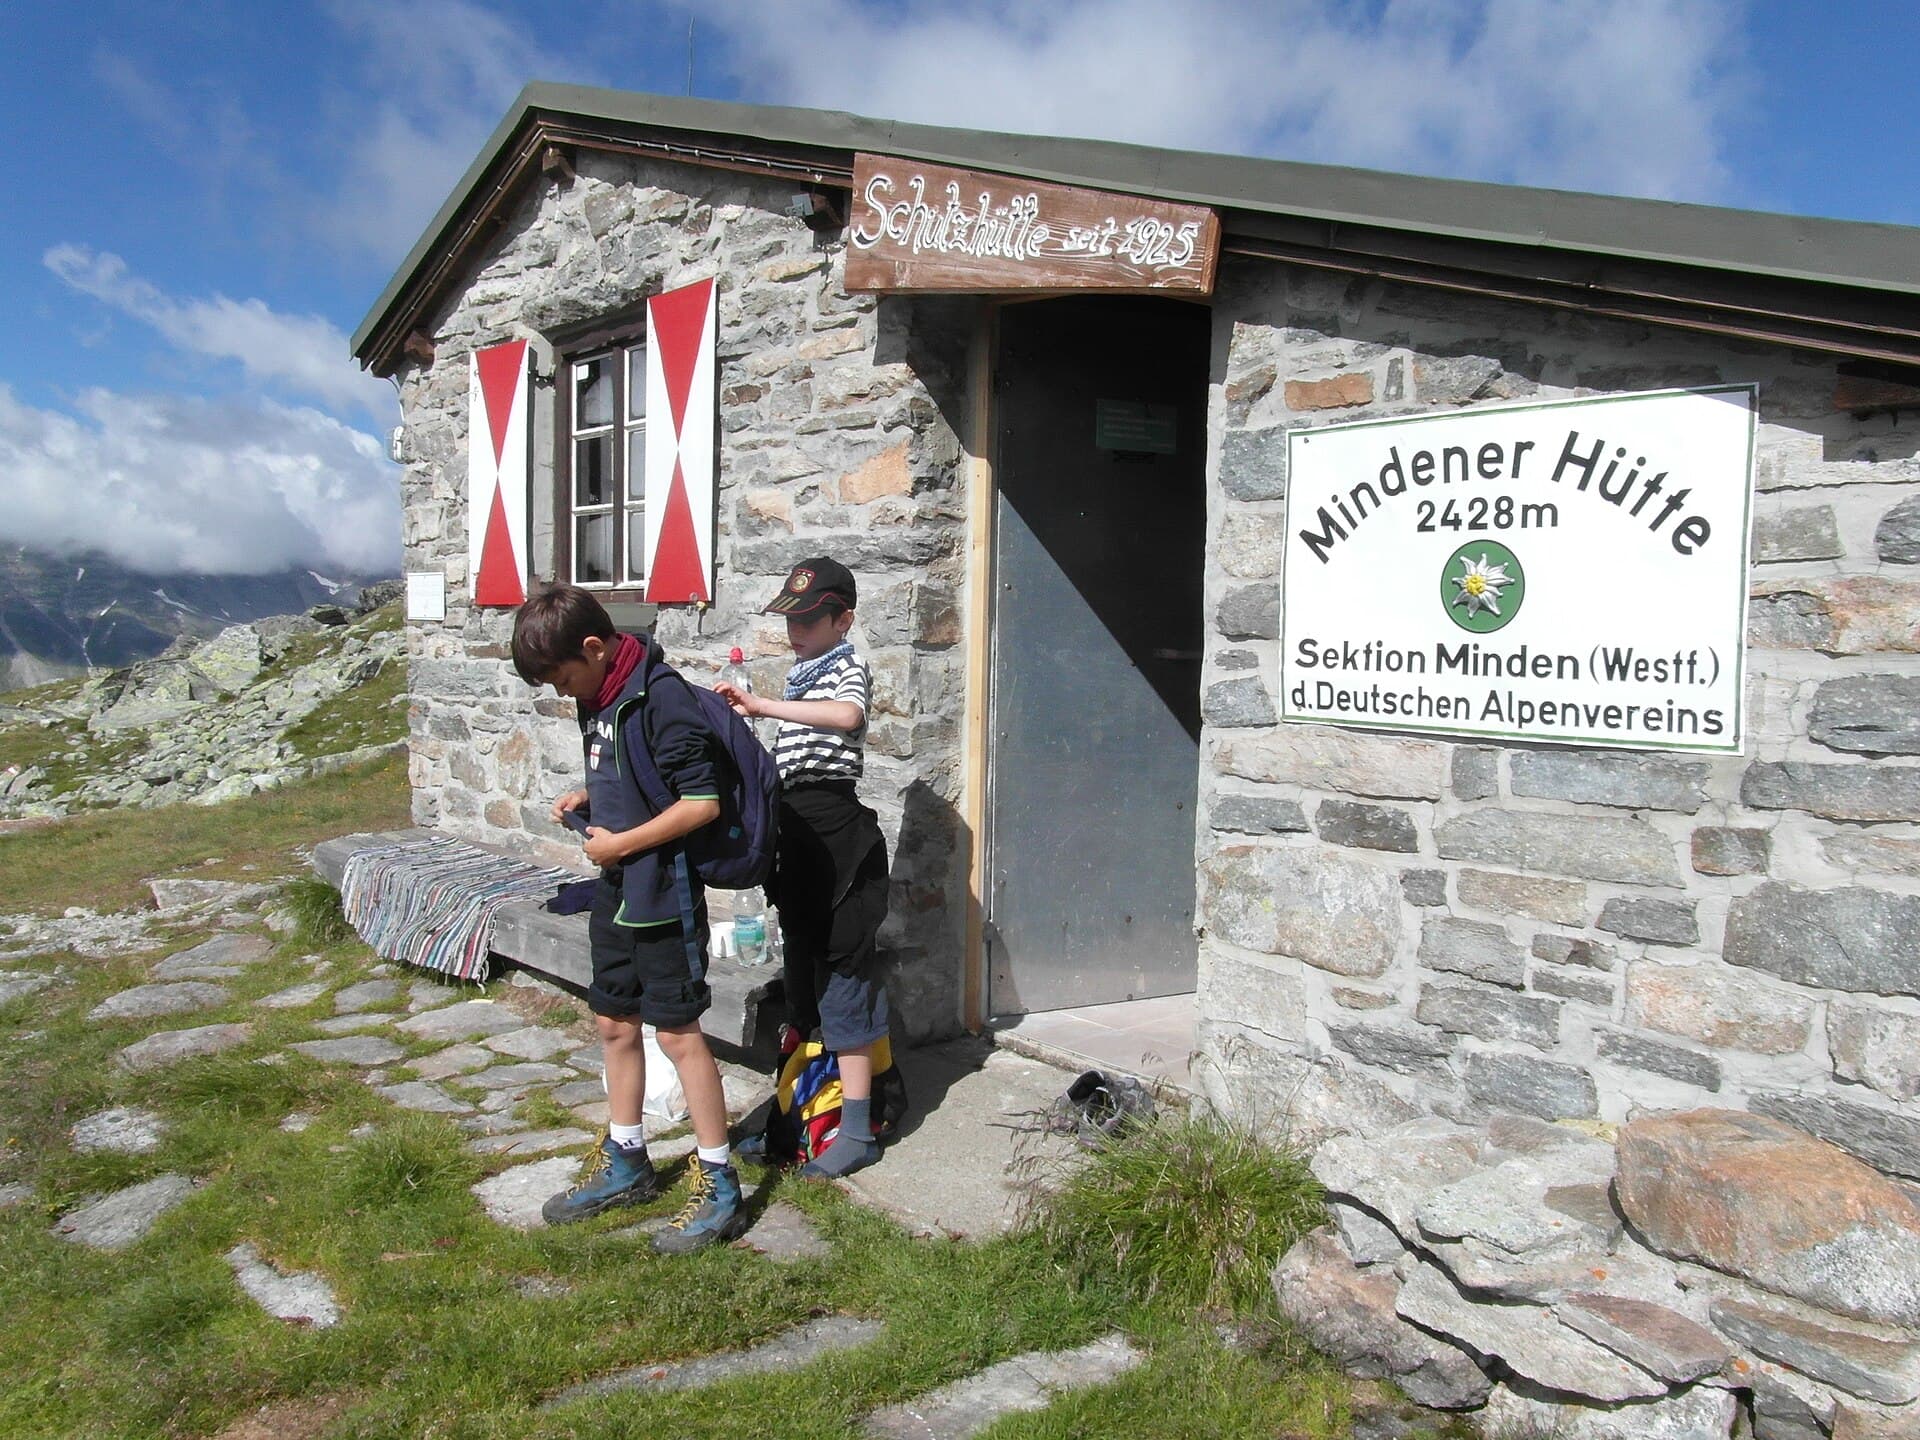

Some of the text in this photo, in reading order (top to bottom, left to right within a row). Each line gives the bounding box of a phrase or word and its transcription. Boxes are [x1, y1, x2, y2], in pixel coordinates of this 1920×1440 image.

[851, 174, 1198, 266] Schutzhütte seit 1925
[1299, 430, 1711, 564] Mindener Hütte
[1417, 495, 1559, 532] 2428m
[1295, 638, 1720, 688] Sektion Minden (Westf.)
[1480, 689, 1723, 735] Alpenvereins
